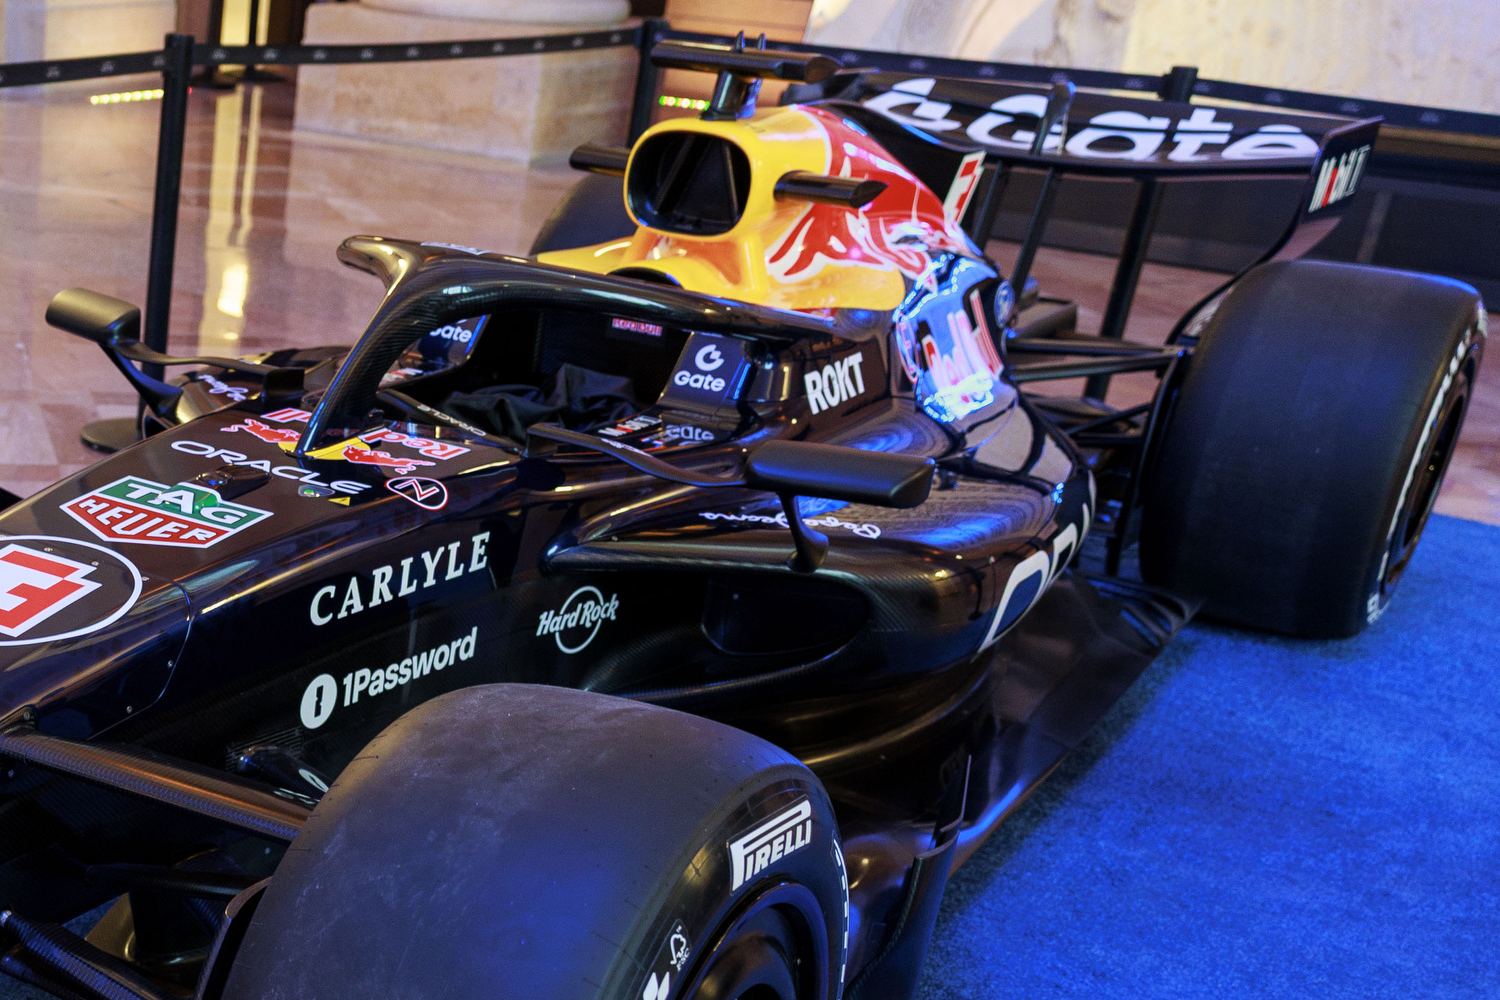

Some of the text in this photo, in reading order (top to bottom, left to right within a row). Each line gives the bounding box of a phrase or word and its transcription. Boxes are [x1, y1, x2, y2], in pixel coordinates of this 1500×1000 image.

[966, 93, 1319, 162] Gate
[674, 370, 726, 392] Gate
[804, 351, 865, 415] ROKT
[171, 440, 373, 495] ORACLE
[358, 428, 471, 460] Red
[78, 498, 219, 542] HEUER
[124, 482, 249, 526] TAG
[309, 531, 490, 627] CARLYLE
[536, 593, 620, 637] Hard Rock
[343, 626, 478, 708] 1Password
[729, 799, 812, 891] PIRELLI
